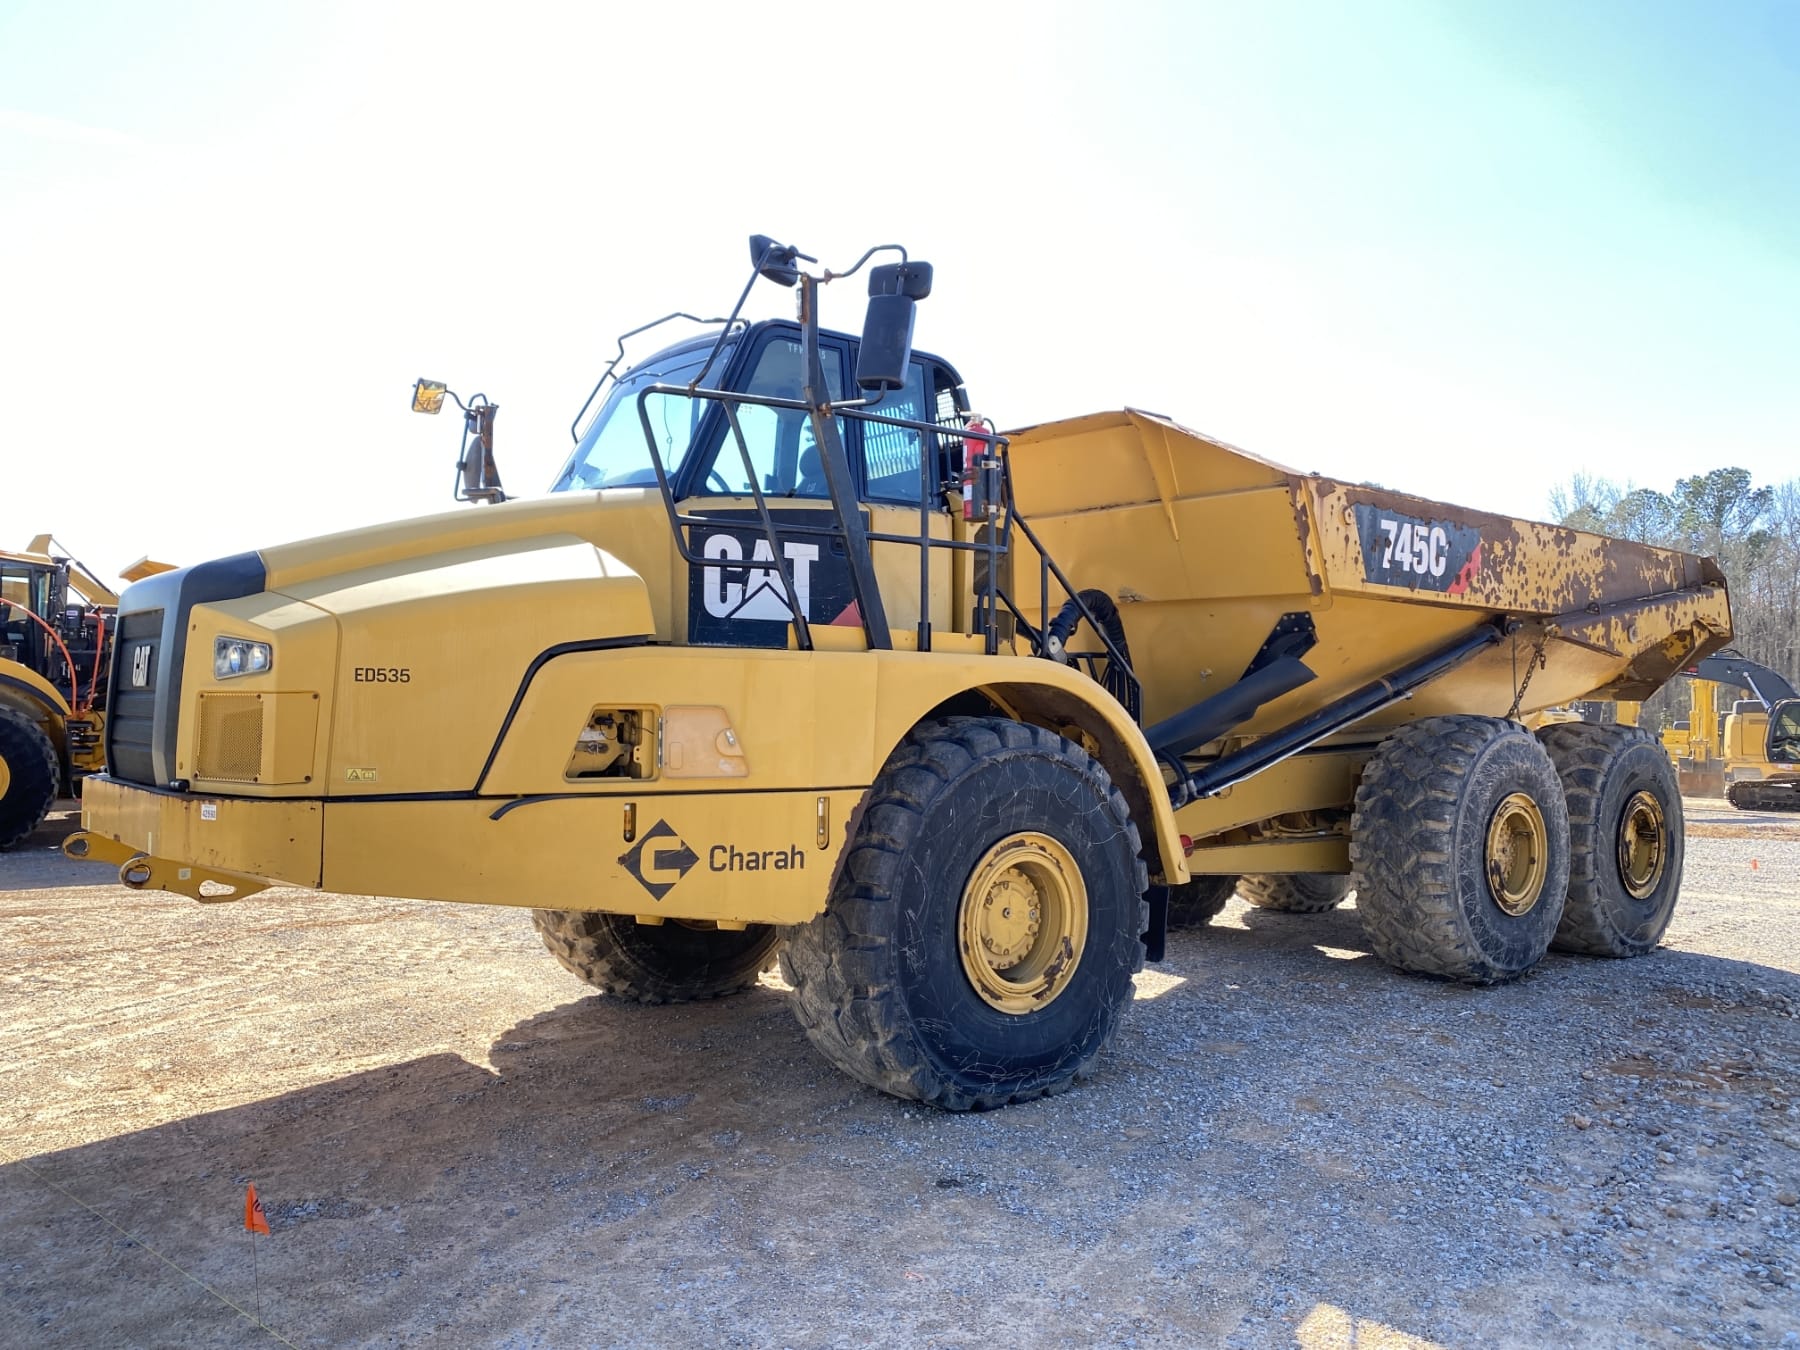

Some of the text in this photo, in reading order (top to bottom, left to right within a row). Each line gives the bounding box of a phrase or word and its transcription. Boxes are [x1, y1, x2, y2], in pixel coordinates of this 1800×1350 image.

[1380, 519, 1447, 577] 745C
[703, 533, 820, 622] CAT
[132, 644, 151, 687] CAT
[354, 667, 411, 683] ED535
[709, 844, 806, 873] Charah
